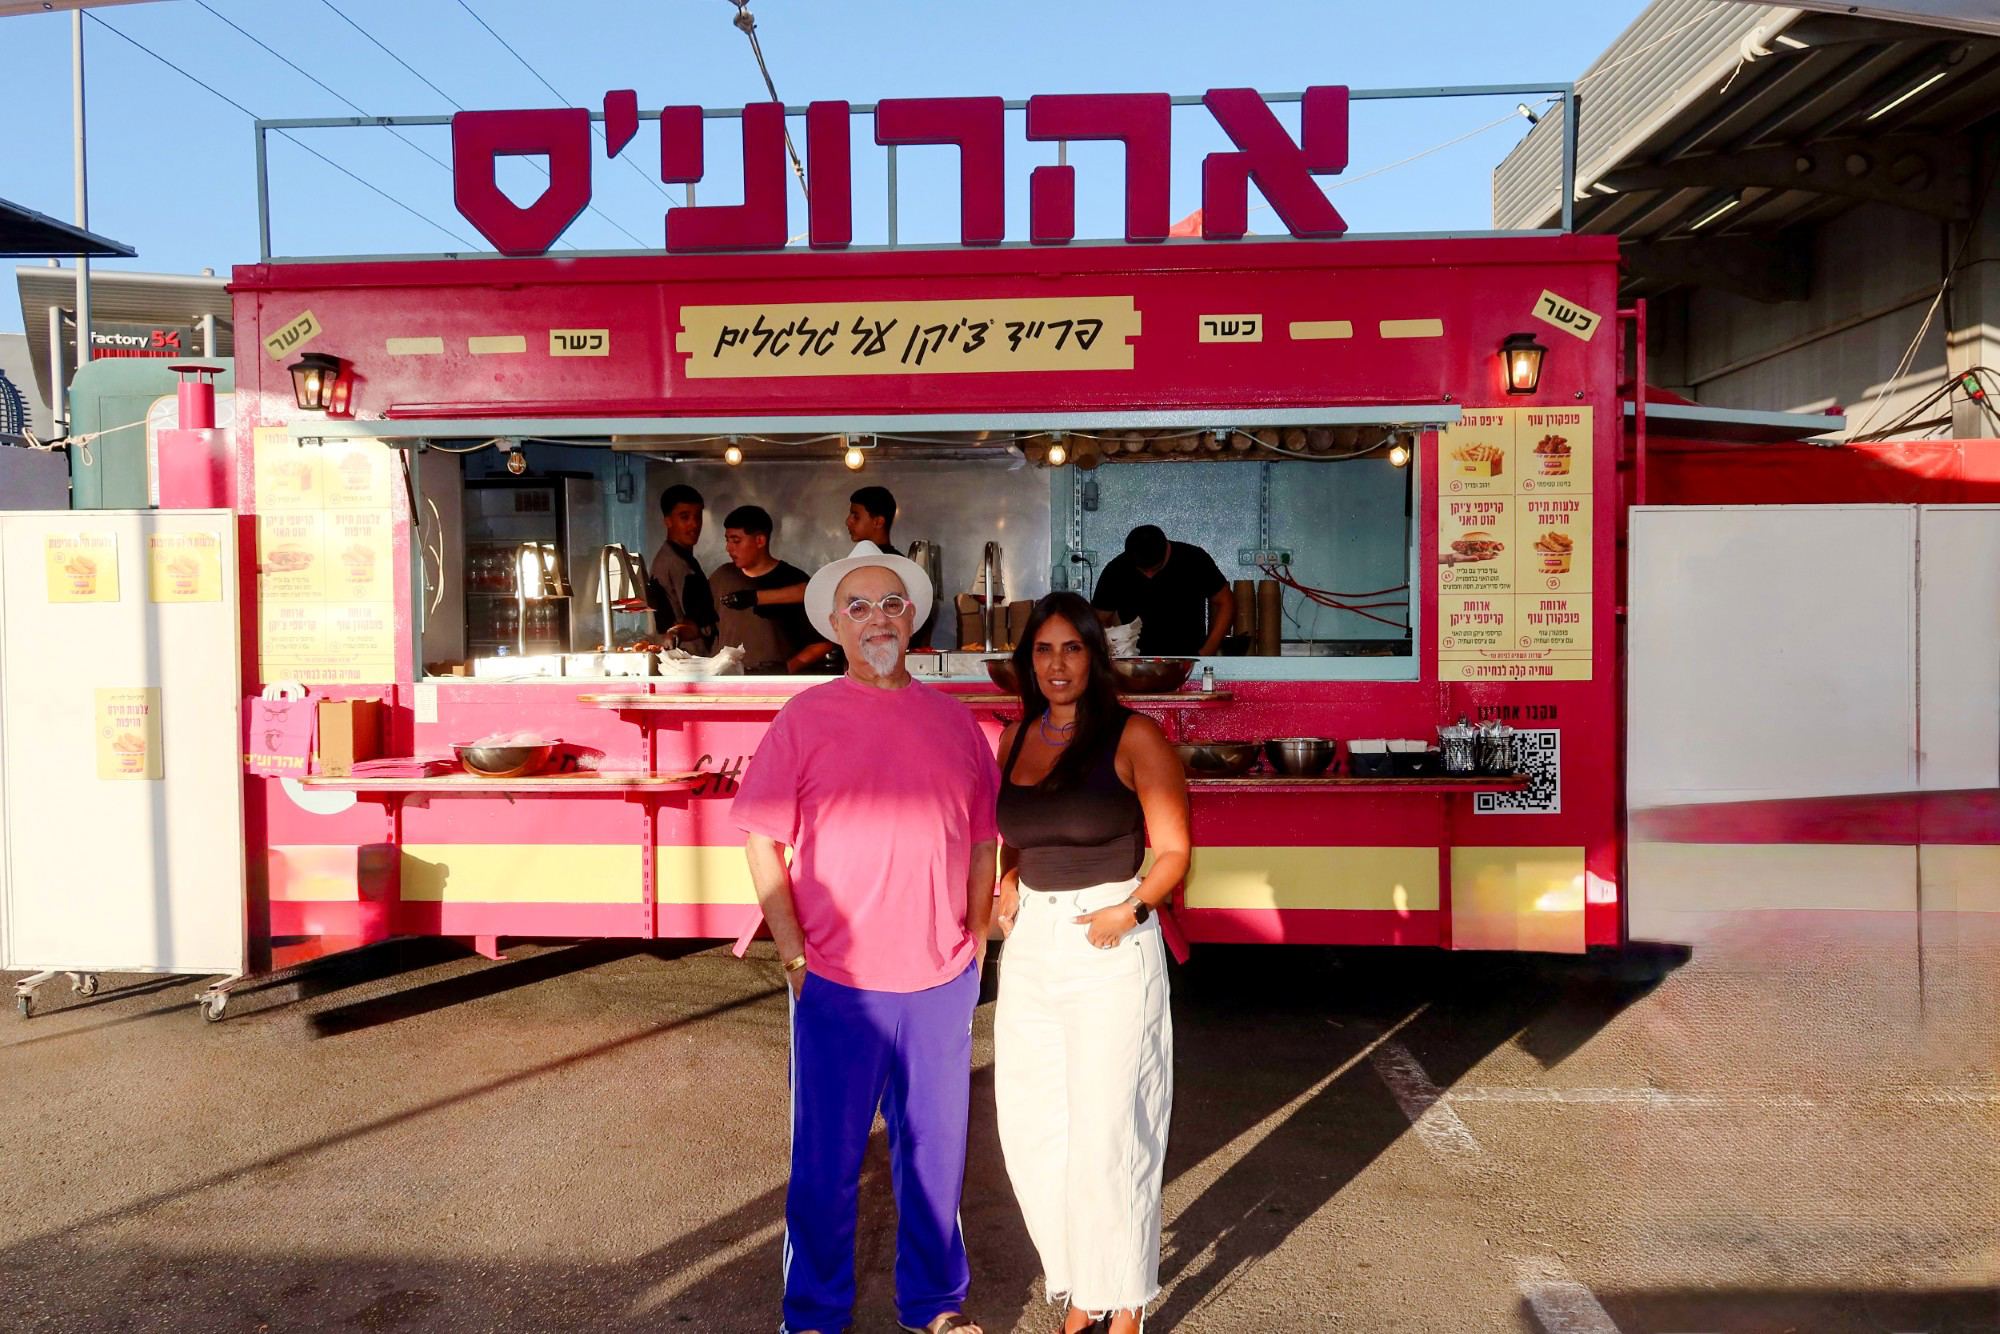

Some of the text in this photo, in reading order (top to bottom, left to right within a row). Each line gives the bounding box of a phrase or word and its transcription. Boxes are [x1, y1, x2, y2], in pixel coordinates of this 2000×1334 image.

[453, 85, 1349, 256] אהרוני'ס
[1544, 297, 1592, 331] כשר
[269, 317, 313, 351] כשר
[1204, 320, 1256, 336] כשר
[151, 330, 181, 349] 54
[554, 334, 603, 350] כשר
[713, 315, 839, 358] גלגלים
[851, 315, 898, 357] על
[1005, 318, 1104, 354] פרייד
[1480, 415, 1504, 426] צ'יפס
[1527, 413, 1580, 428] פופקורן עוף
[1450, 502, 1504, 516] קריספי צ'יקן
[1528, 499, 1580, 512] צלעות תירס
[1458, 515, 1496, 526] הוט האני
[1538, 513, 1569, 525] חריפות
[1463, 601, 1490, 612] ארוחת
[1540, 600, 1567, 611] ארוחת
[1450, 613, 1504, 627] קריספי צ'יקן
[1527, 612, 1580, 626] פופקורן עוף
[1477, 664, 1553, 678] שתיה קלה לבחירה
[1525, 705, 1558, 720] עקבו
